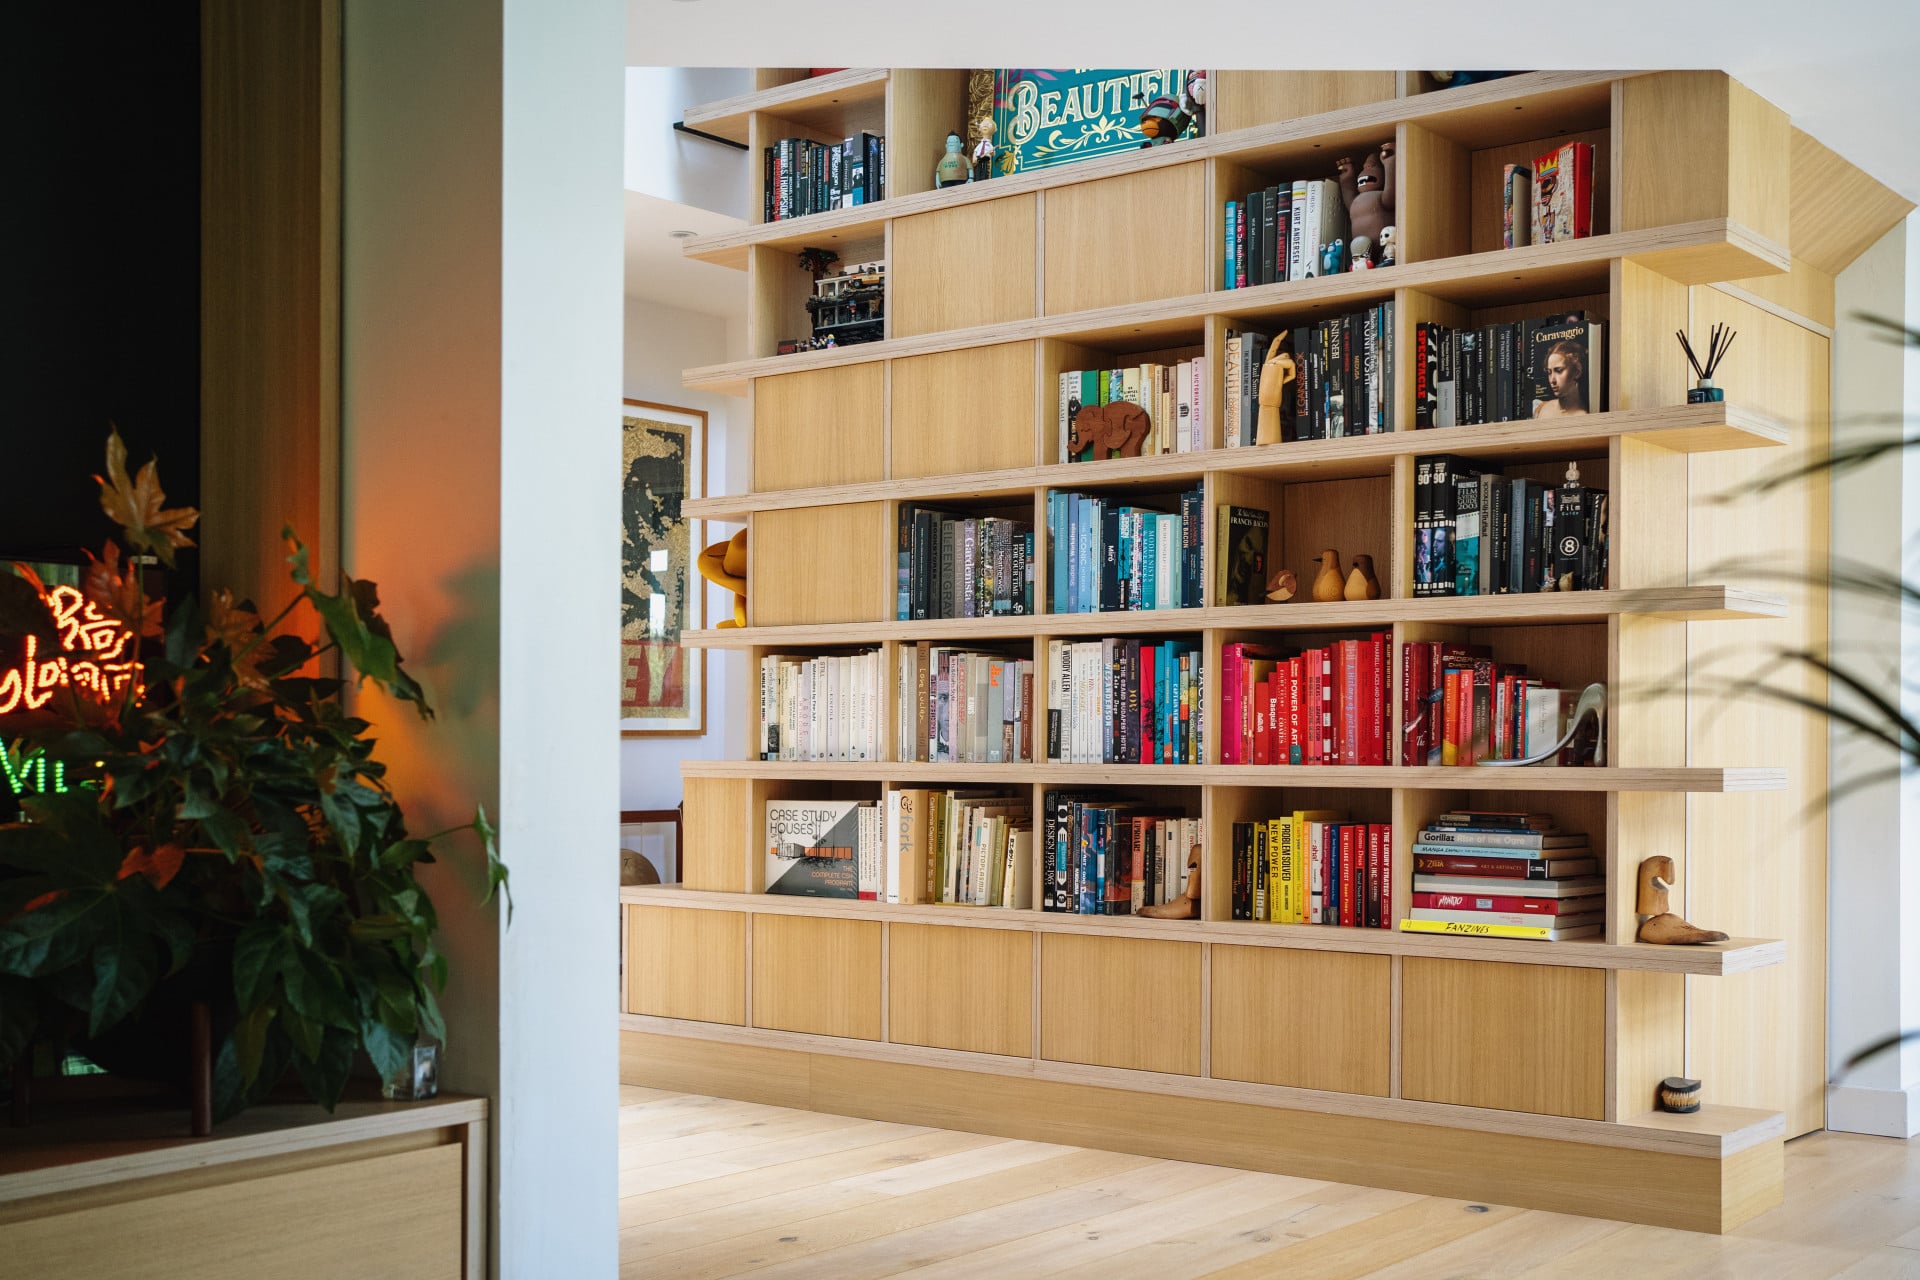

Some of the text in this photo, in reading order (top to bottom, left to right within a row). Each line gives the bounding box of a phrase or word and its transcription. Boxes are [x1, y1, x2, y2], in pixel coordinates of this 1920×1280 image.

[780, 140, 788, 169] HUNTER
[780, 176, 788, 216] THOMPSON
[1236, 234, 1243, 243] Do
[1278, 216, 1286, 272] KURT ANDERSEN
[1292, 206, 1301, 264] KURT ANDERSEN
[1535, 326, 1584, 344] Caravaggio
[1228, 342, 1240, 387] DEATH
[1418, 329, 1426, 399] SPECTACLE
[1230, 511, 1252, 526] FRANCIS
[1107, 545, 1115, 562] Miró
[1564, 539, 1575, 553] 8
[942, 522, 953, 618] EILEEN GRAY
[964, 538, 974, 602] Gardenista
[1062, 650, 1071, 672] WOODY
[918, 668, 927, 688] Love
[1062, 674, 1071, 693] ALLEN
[1346, 672, 1355, 700] History
[1104, 663, 1112, 727] WES ANDERSON
[1269, 698, 1277, 730] Basquiat
[1290, 679, 1298, 746] POWER OF ART
[1346, 714, 1355, 748] pictures
[769, 809, 838, 823] CASE STUDY
[769, 822, 814, 835] HOUSES
[900, 796, 914, 853] & fork
[928, 797, 936, 855] California Captured
[1047, 819, 1056, 850] DESIGN
[1133, 820, 1142, 852] UPROAR!
[1370, 833, 1378, 867] CREATIVITY,
[1424, 832, 1455, 842] Gorillaz
[1456, 834, 1476, 843] Rise
[1477, 835, 1486, 843] of
[1503, 837, 1525, 846] Ogre
[1270, 823, 1278, 879] NEW POWER
[1281, 824, 1291, 882] PROBLEM SOLVED
[1311, 844, 1319, 862] aha!
[1426, 859, 1444, 868] ZELDA
[811, 871, 841, 879] COMPLETE
[978, 843, 987, 894] PICTOPLASMA
[1445, 922, 1491, 935] FANZINES
